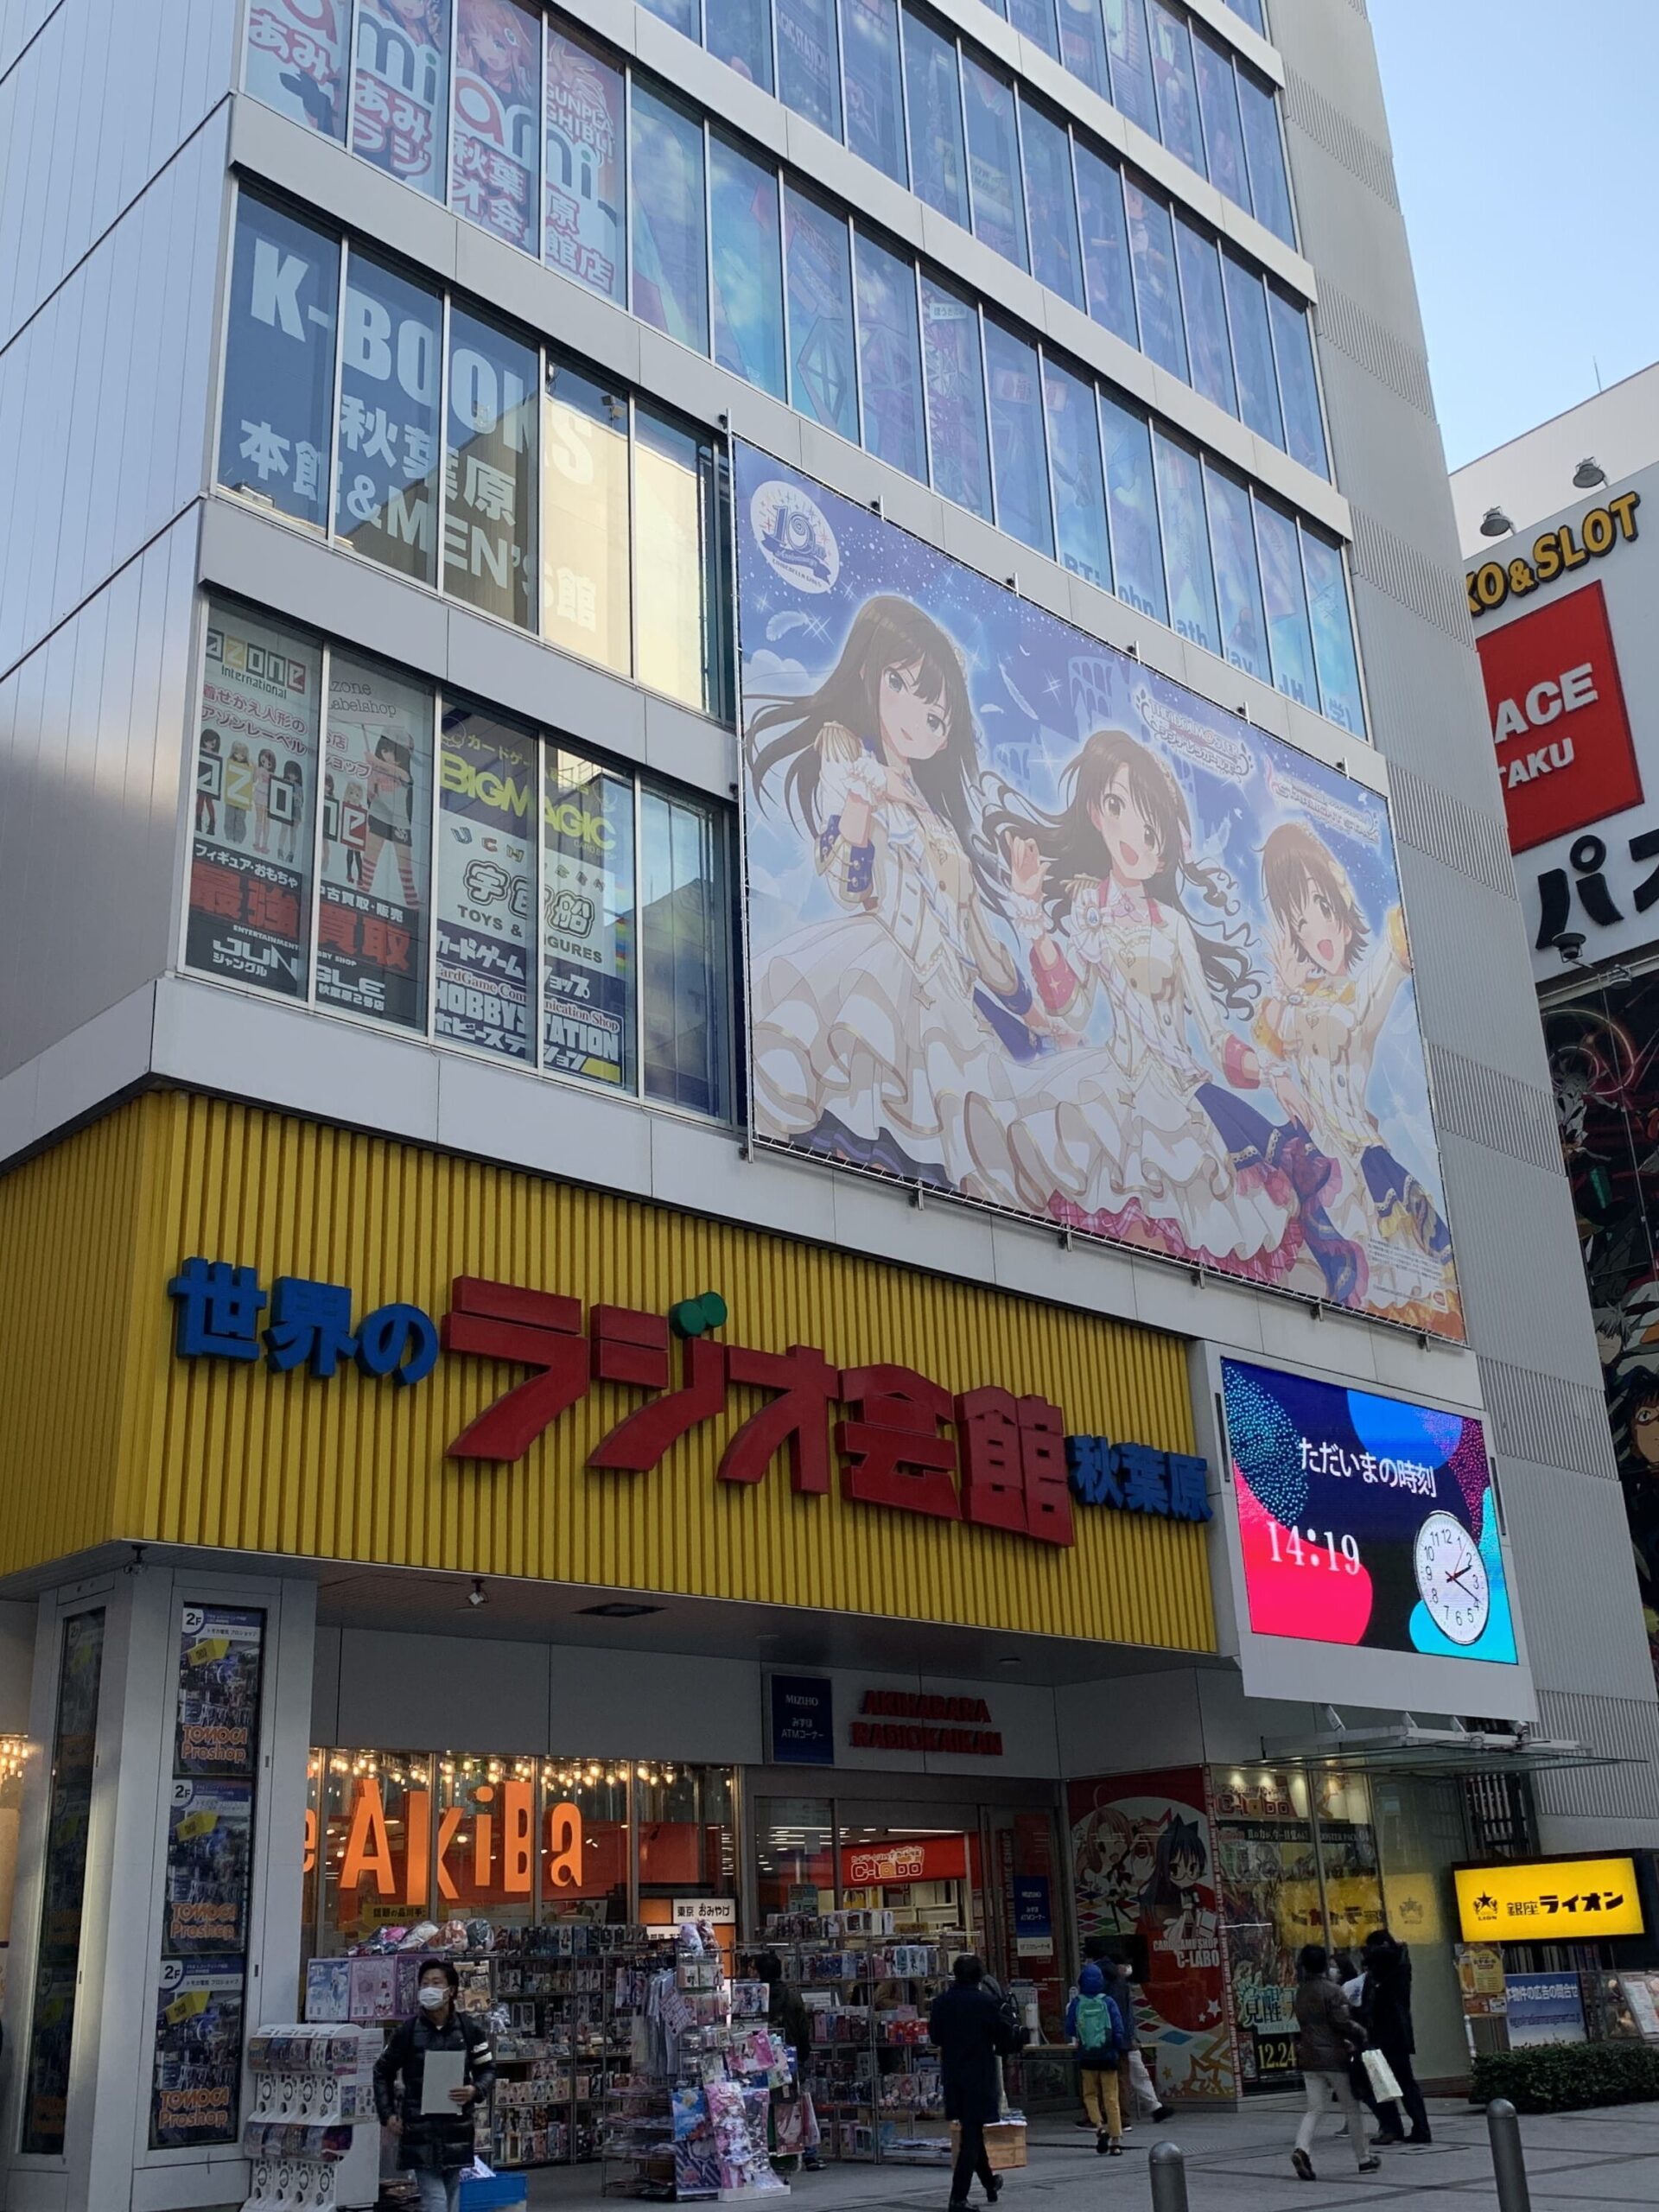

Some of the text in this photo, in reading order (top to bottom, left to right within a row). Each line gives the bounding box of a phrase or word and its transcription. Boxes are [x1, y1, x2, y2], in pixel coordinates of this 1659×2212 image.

[353, 115, 613, 295] ラジオ会館店
[340, 394, 516, 525] 秋葉原
[221, 664, 288, 699] International
[330, 680, 372, 696] zone
[1494, 663, 1599, 744] ACE
[439, 750, 616, 851] BIGMAGIC
[194, 842, 299, 889] フィギュア・おもちゃ
[190, 864, 411, 972] 最強買取
[457, 904, 603, 963] TOYS & IGURES
[212, 952, 268, 977] ジャングル
[499, 983, 590, 1021] Comnication
[591, 1010, 620, 1033] Shop
[435, 1011, 588, 1071] ホビーステション
[169, 1256, 1211, 1548] 世界の ラジオ会館 秋葉原
[1300, 1437, 1437, 1498] ただいまの時刻
[1442, 1529, 1452, 1544] 12
[1267, 1521, 1361, 1575] 14:19
[1425, 1546, 1434, 1561] 10
[1426, 1566, 1433, 1580] 9
[1472, 1574, 1479, 1589] 3
[1432, 1588, 1439, 1604] 8
[186, 1612, 202, 1626] 2F
[1444, 1605, 1449, 1620] 7
[1455, 1611, 1462, 1626] 6
[1467, 1608, 1473, 1623] 5
[785, 1694, 819, 1707] MIZUHO
[861, 1689, 992, 1723] AKIHABARA
[791, 1716, 813, 1729] みずほ
[182, 1726, 248, 1745] TOMOCA
[781, 1728, 825, 1739] ATMコーナー
[181, 1743, 247, 1764] Proshop
[175, 1785, 192, 1798] 2F
[677, 1903, 730, 1916] 東京 おみやげ
[1507, 1891, 1624, 1916] 銀座ライオン
[1176, 1949, 1220, 1969] C-LABO
[164, 1965, 181, 1980] 2F
[1257, 2041, 1297, 2070] 12.24
[159, 2087, 230, 2108] TOMOCA
[157, 2108, 229, 2129] Proshop
